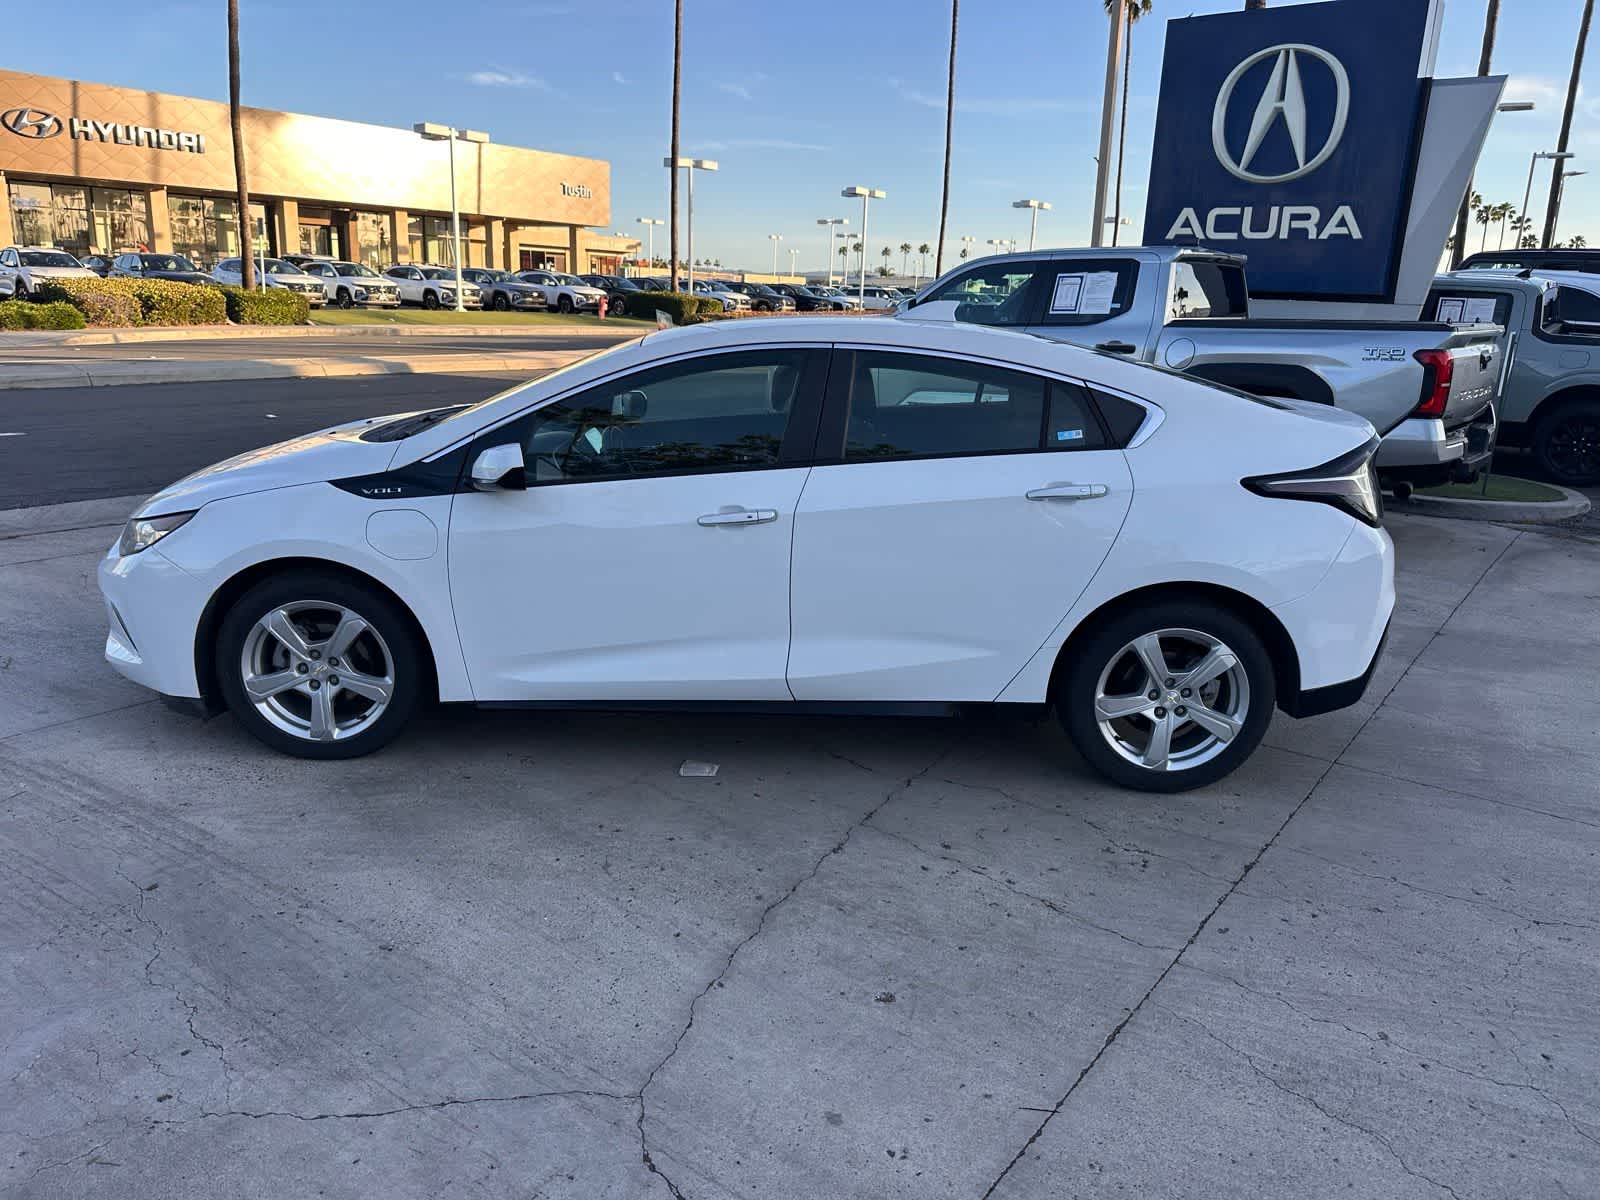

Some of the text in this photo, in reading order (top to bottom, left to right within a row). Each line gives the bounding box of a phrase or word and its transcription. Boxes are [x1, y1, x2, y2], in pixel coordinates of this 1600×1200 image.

[69, 116, 206, 154] HYUNDAI
[560, 181, 592, 199] Tustin
[1164, 205, 1363, 240] ACURA
[1363, 346, 1406, 358] TRD
